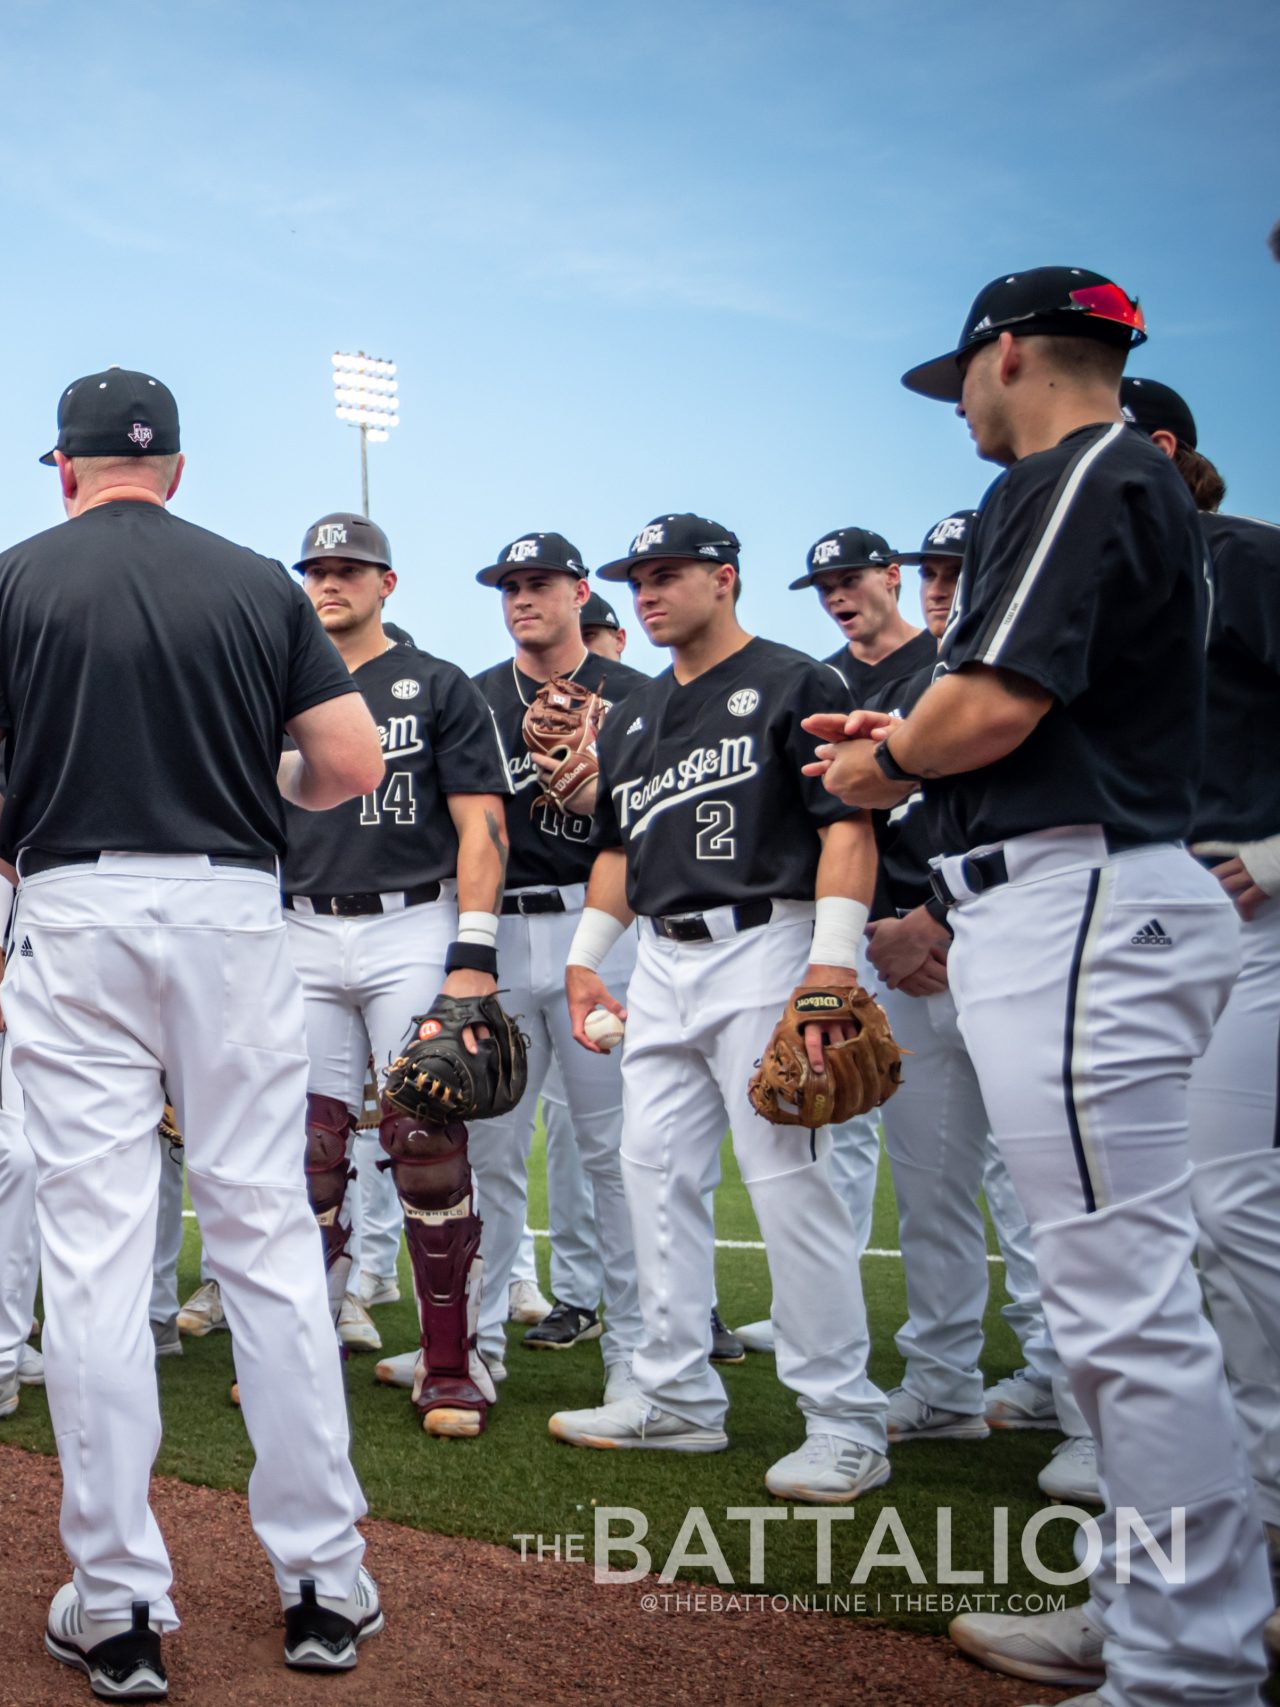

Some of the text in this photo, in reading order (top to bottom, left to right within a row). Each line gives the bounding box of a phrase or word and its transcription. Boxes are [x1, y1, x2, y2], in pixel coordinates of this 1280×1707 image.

[393, 680, 419, 699] SEC
[729, 690, 757, 715] SEC
[376, 714, 419, 750] &M
[554, 762, 588, 792] Wilson
[611, 736, 755, 829] Texas A&M
[360, 772, 416, 825] 14
[696, 801, 735, 860] 2
[1131, 935, 1173, 945] adidas
[796, 996, 840, 1009] Wilson
